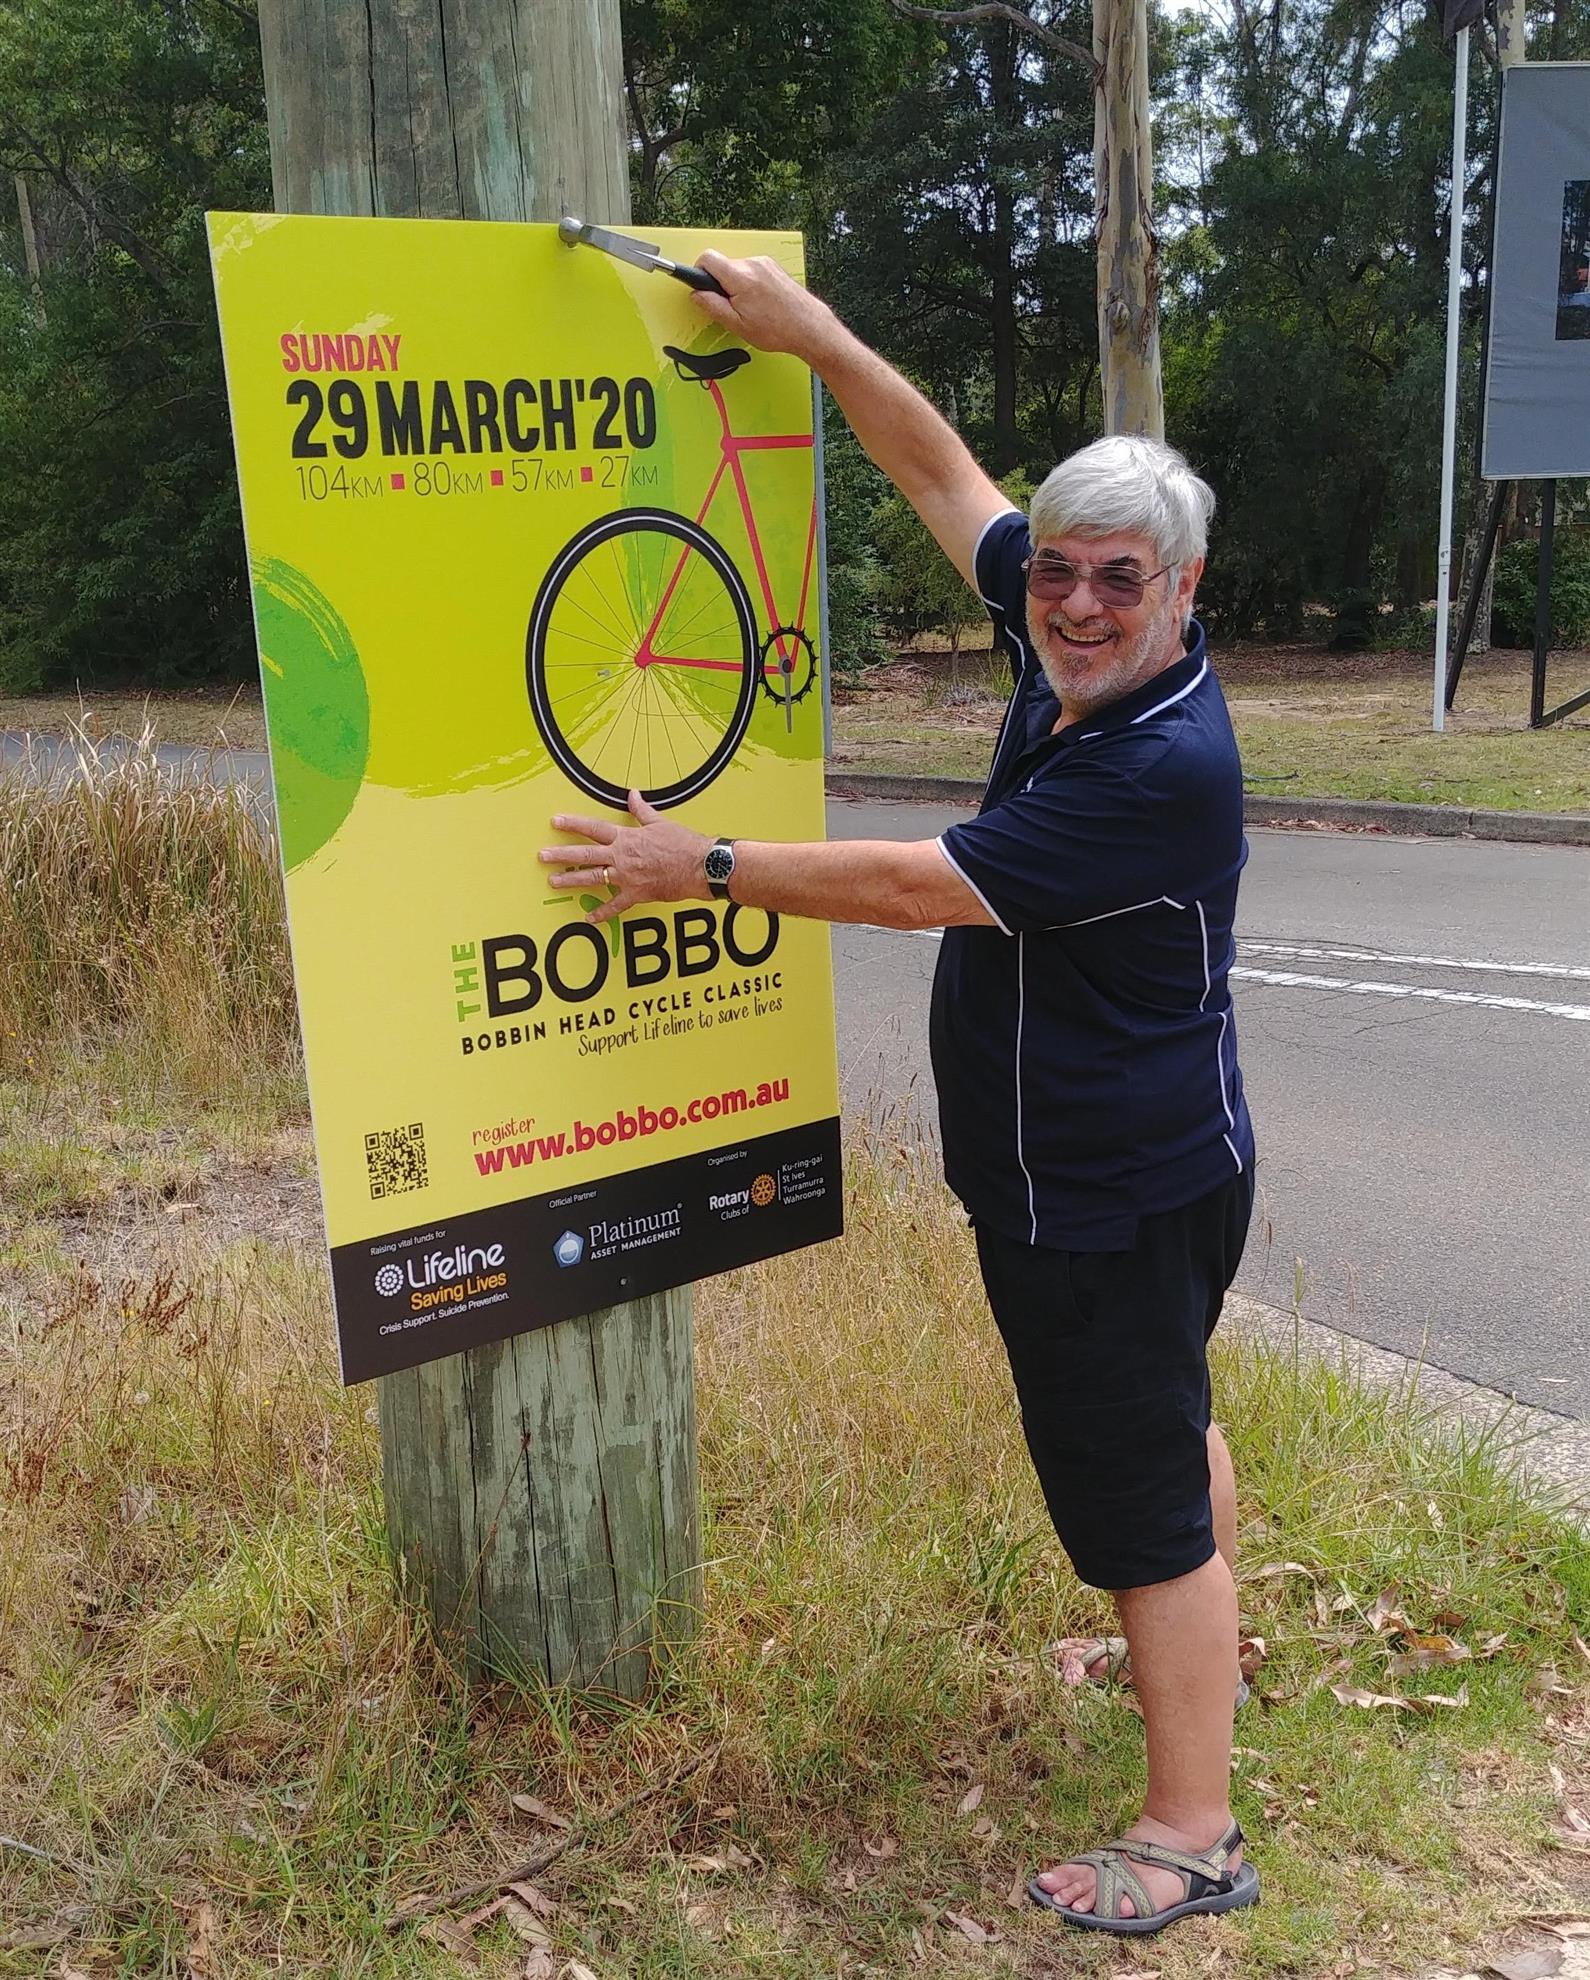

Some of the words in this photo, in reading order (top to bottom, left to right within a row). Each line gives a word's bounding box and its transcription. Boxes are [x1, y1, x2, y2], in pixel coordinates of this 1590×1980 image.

[280, 333, 402, 373] SUNDAY
[296, 464, 384, 501] 104KM
[413, 461, 484, 496] 80KM
[511, 458, 575, 493] 57KM
[599, 455, 659, 489] 27KM
[481, 902, 780, 1018] BOBBO
[451, 941, 481, 1023] THE
[461, 1020, 547, 1056] BOBBIN
[559, 1007, 616, 1035] HEAD
[628, 990, 692, 1019] CYCLE
[704, 972, 783, 1003] CLASSIC
[578, 1024, 639, 1057] Support
[644, 1013, 695, 1041] Lifeline
[699, 1010, 713, 1029] to
[718, 1005, 750, 1024] save
[754, 996, 783, 1017] lives
[472, 1116, 536, 1146] register
[473, 1077, 790, 1177] www.bobbo.com.au
[707, 1151, 739, 1166] Organised
[739, 1150, 748, 1159] by
[782, 1154, 823, 1172] Ku-ring-gai
[782, 1174, 790, 1184] St
[792, 1171, 806, 1181] Ives
[783, 1177, 824, 1194] Turramurra
[548, 1195, 573, 1209] Official
[573, 1190, 598, 1202] Partner
[709, 1189, 750, 1211] Rotary
[720, 1207, 741, 1220] Clubs
[741, 1204, 750, 1214] of
[783, 1187, 826, 1205] Wahroonga
[370, 1242, 397, 1256] Raising
[397, 1239, 413, 1249] vital
[414, 1233, 435, 1246] funds
[435, 1229, 447, 1239] for
[590, 1246, 617, 1260] ASSET
[621, 1227, 682, 1252] MANAGEMENT
[406, 1243, 506, 1289] Lifeline
[410, 1284, 465, 1311] Saving
[466, 1272, 507, 1295] Lives
[379, 1323, 402, 1336] Crisis
[402, 1312, 438, 1329] Support.
[438, 1303, 467, 1319] Suicide
[468, 1292, 510, 1311] Prevention.
